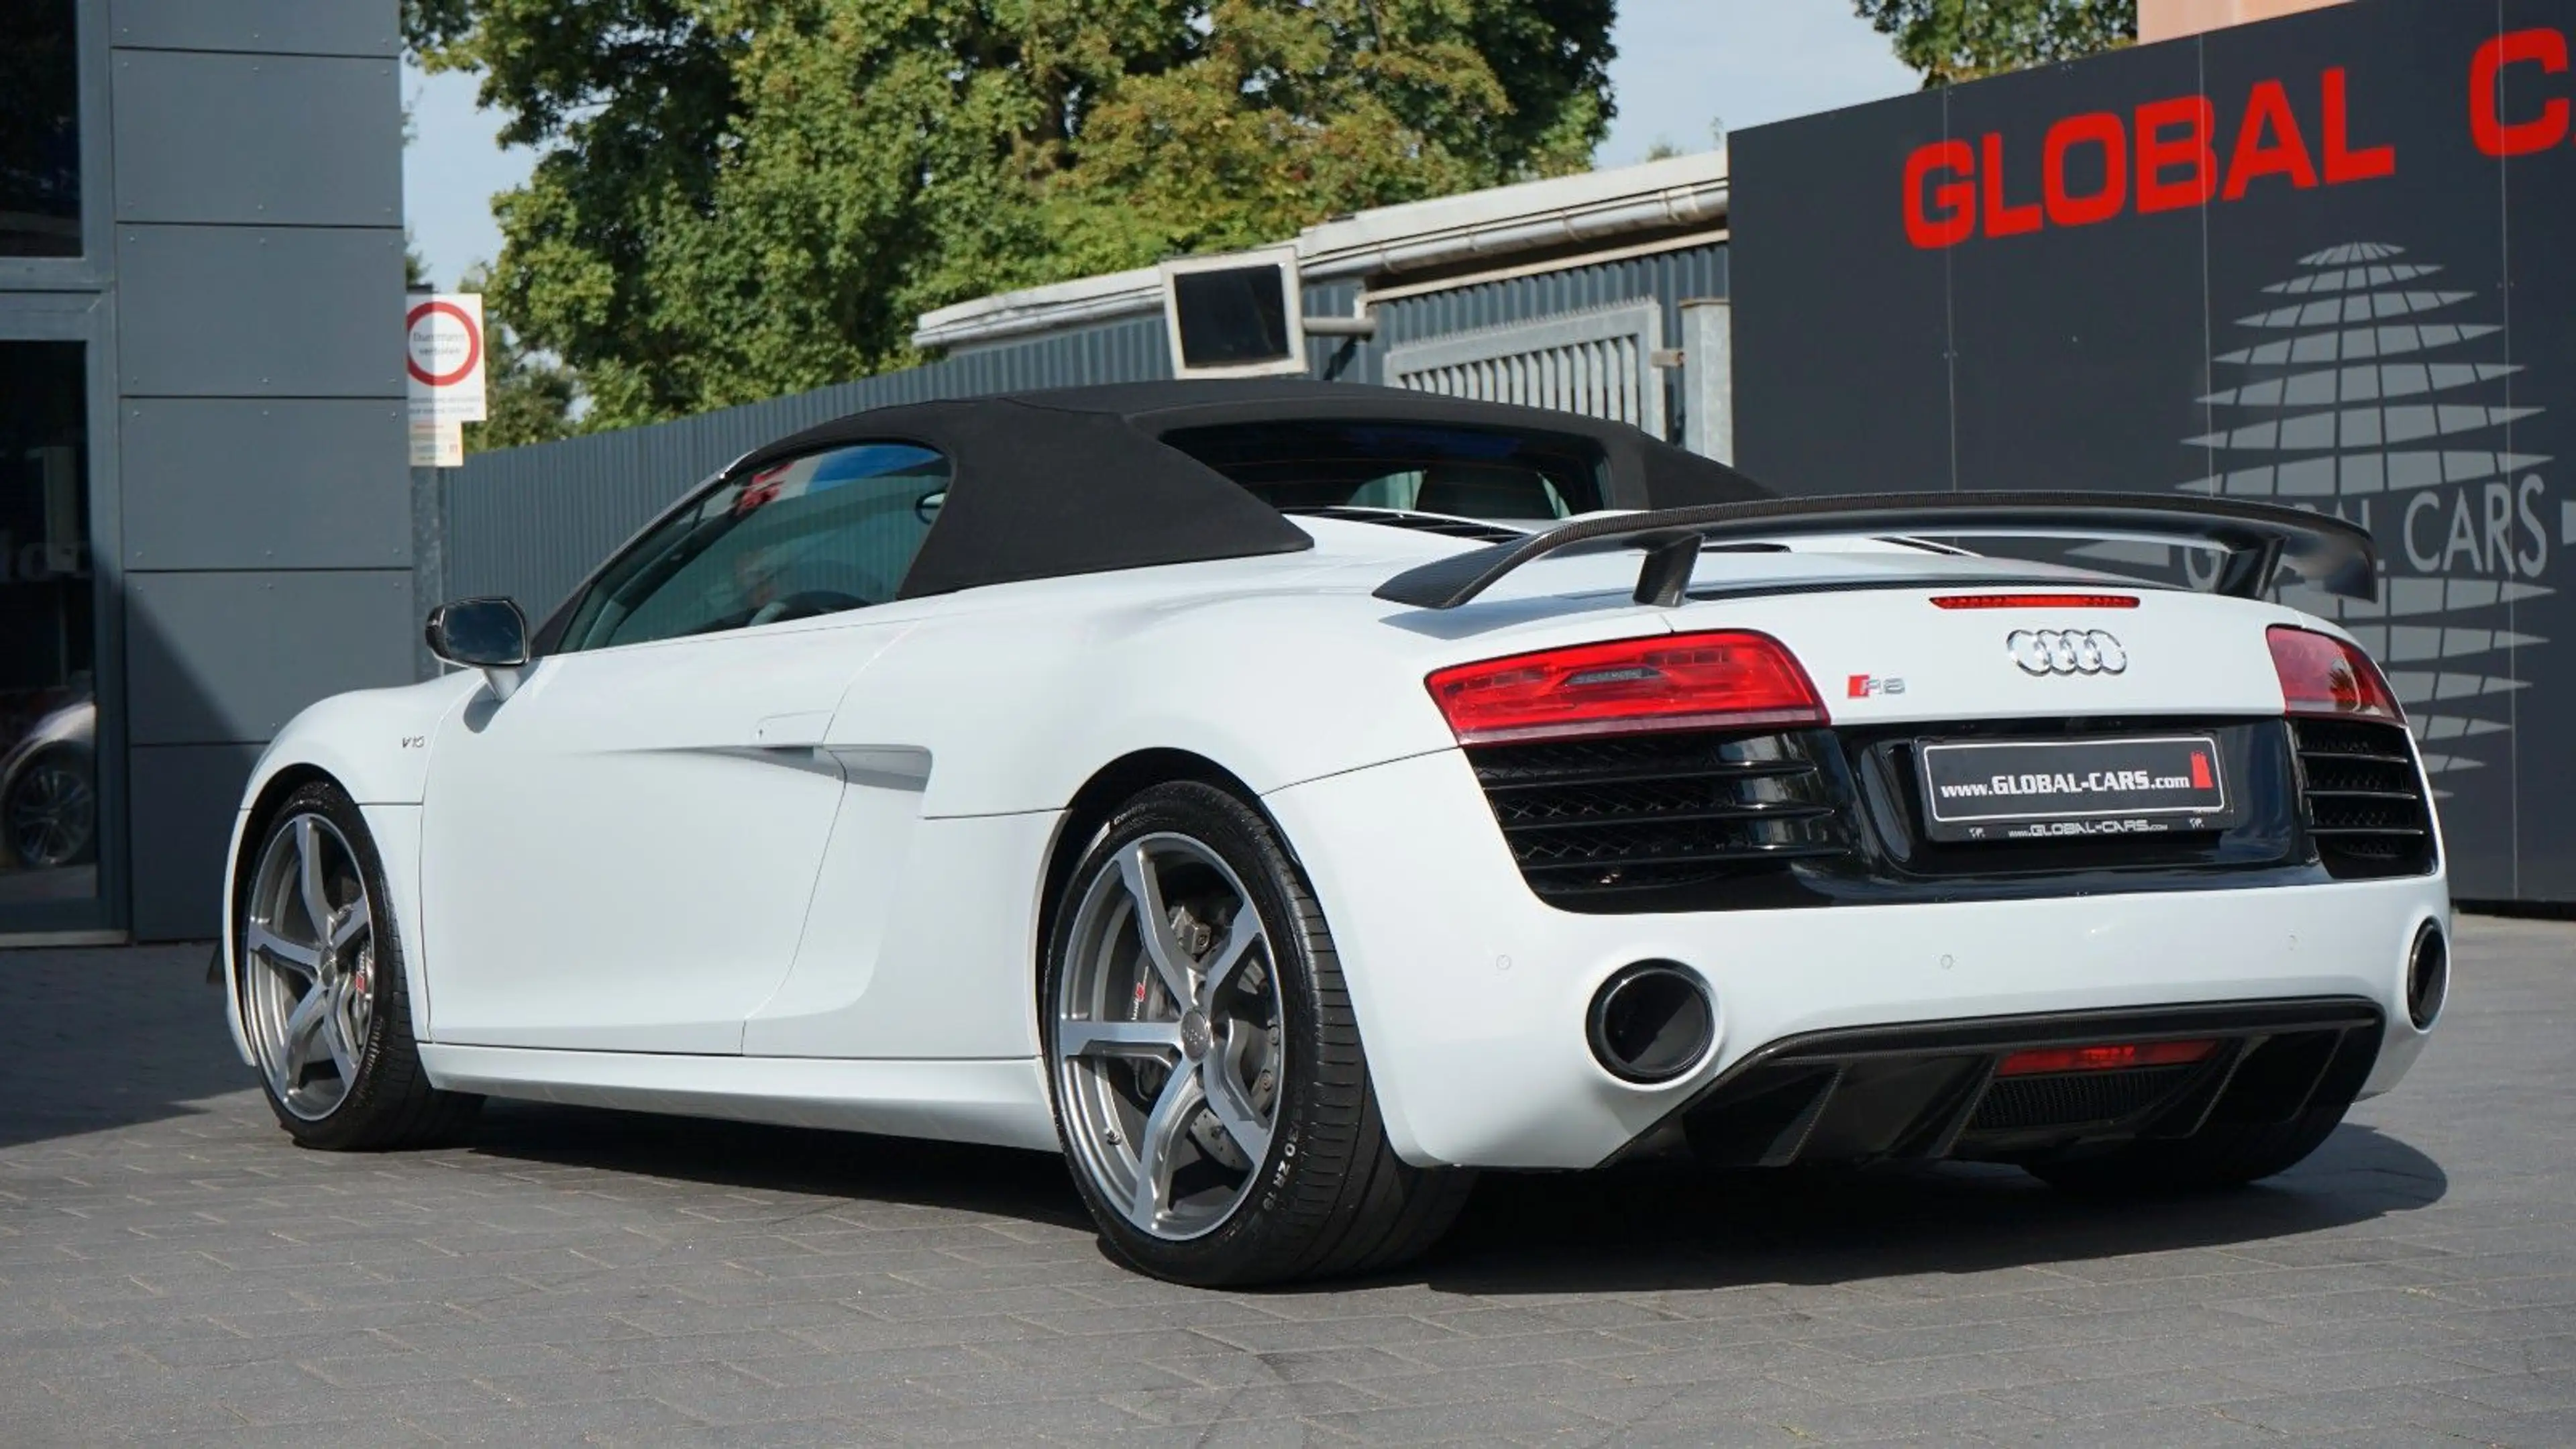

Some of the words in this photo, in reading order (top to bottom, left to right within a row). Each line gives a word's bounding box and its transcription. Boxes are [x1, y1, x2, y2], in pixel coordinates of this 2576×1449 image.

[1903, 68, 2395, 248] GLOBAL
[2470, 28, 2576, 156] C
[2404, 474, 2547, 578] CARS
[402, 735, 424, 747] V10
[1941, 771, 2190, 798] www.GLOBAL-CARS.com
